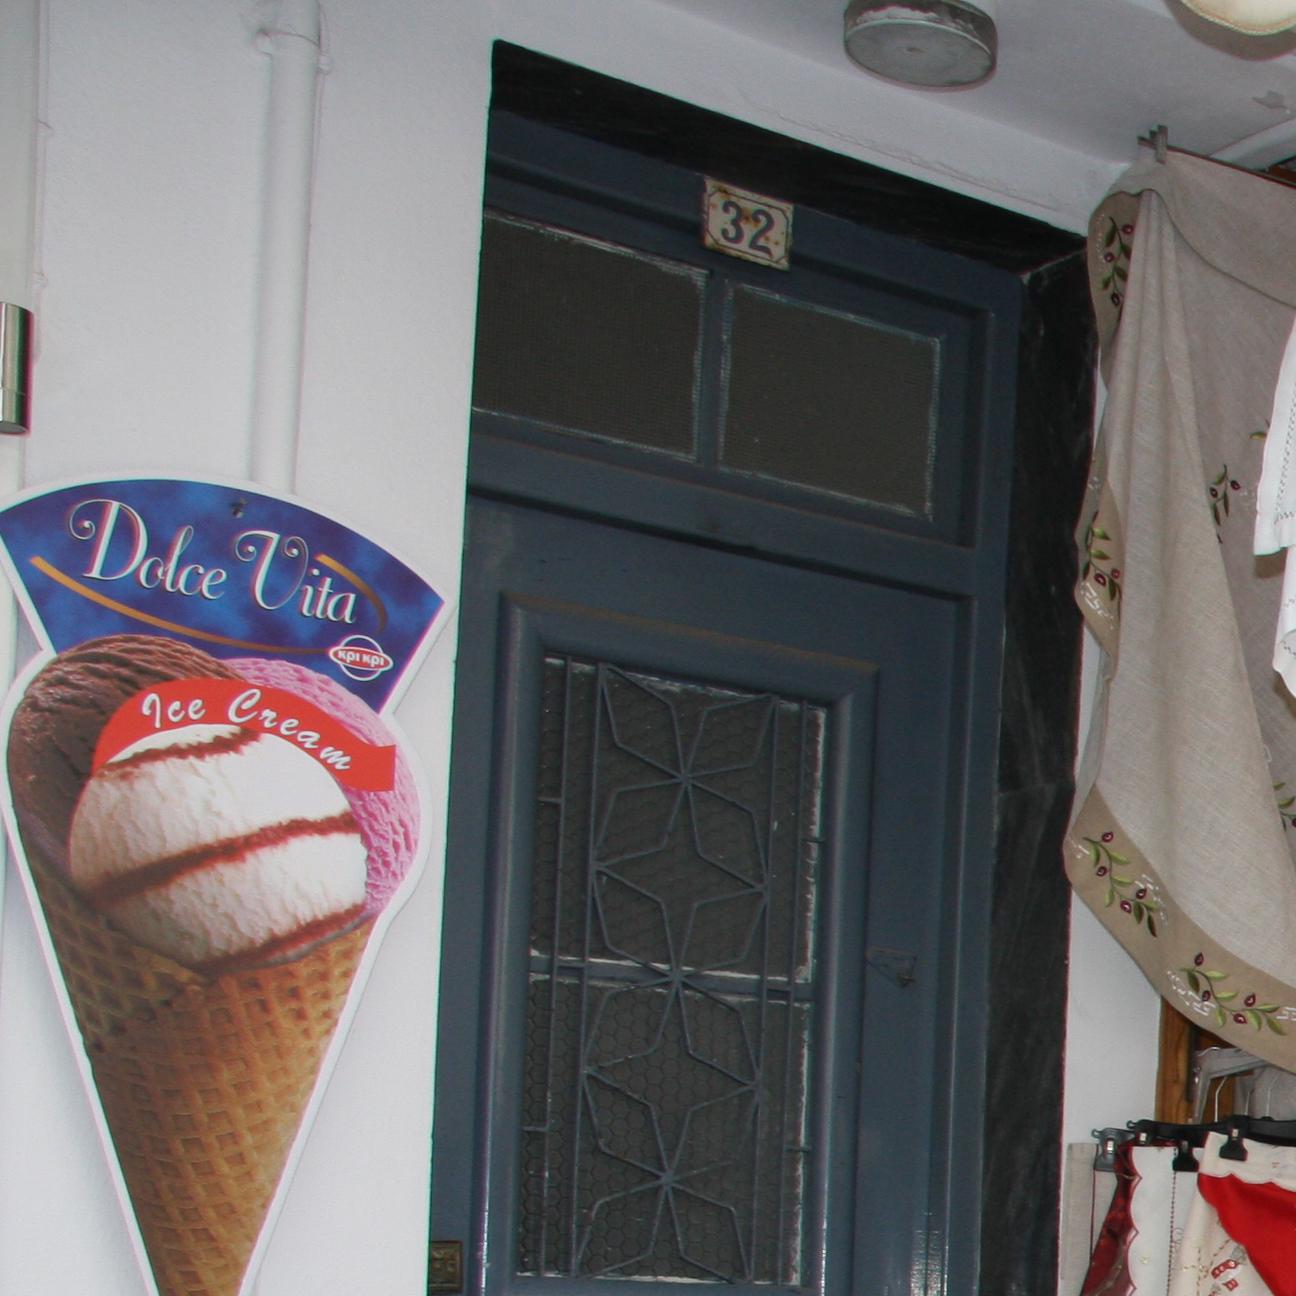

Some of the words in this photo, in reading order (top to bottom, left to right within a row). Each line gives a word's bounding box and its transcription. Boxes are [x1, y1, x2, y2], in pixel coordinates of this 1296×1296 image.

[720, 200, 775, 259] 32
[69, 498, 228, 600] Dolce
[235, 530, 358, 624] Vita
[141, 692, 206, 729] Ice
[227, 687, 352, 771] Cream
